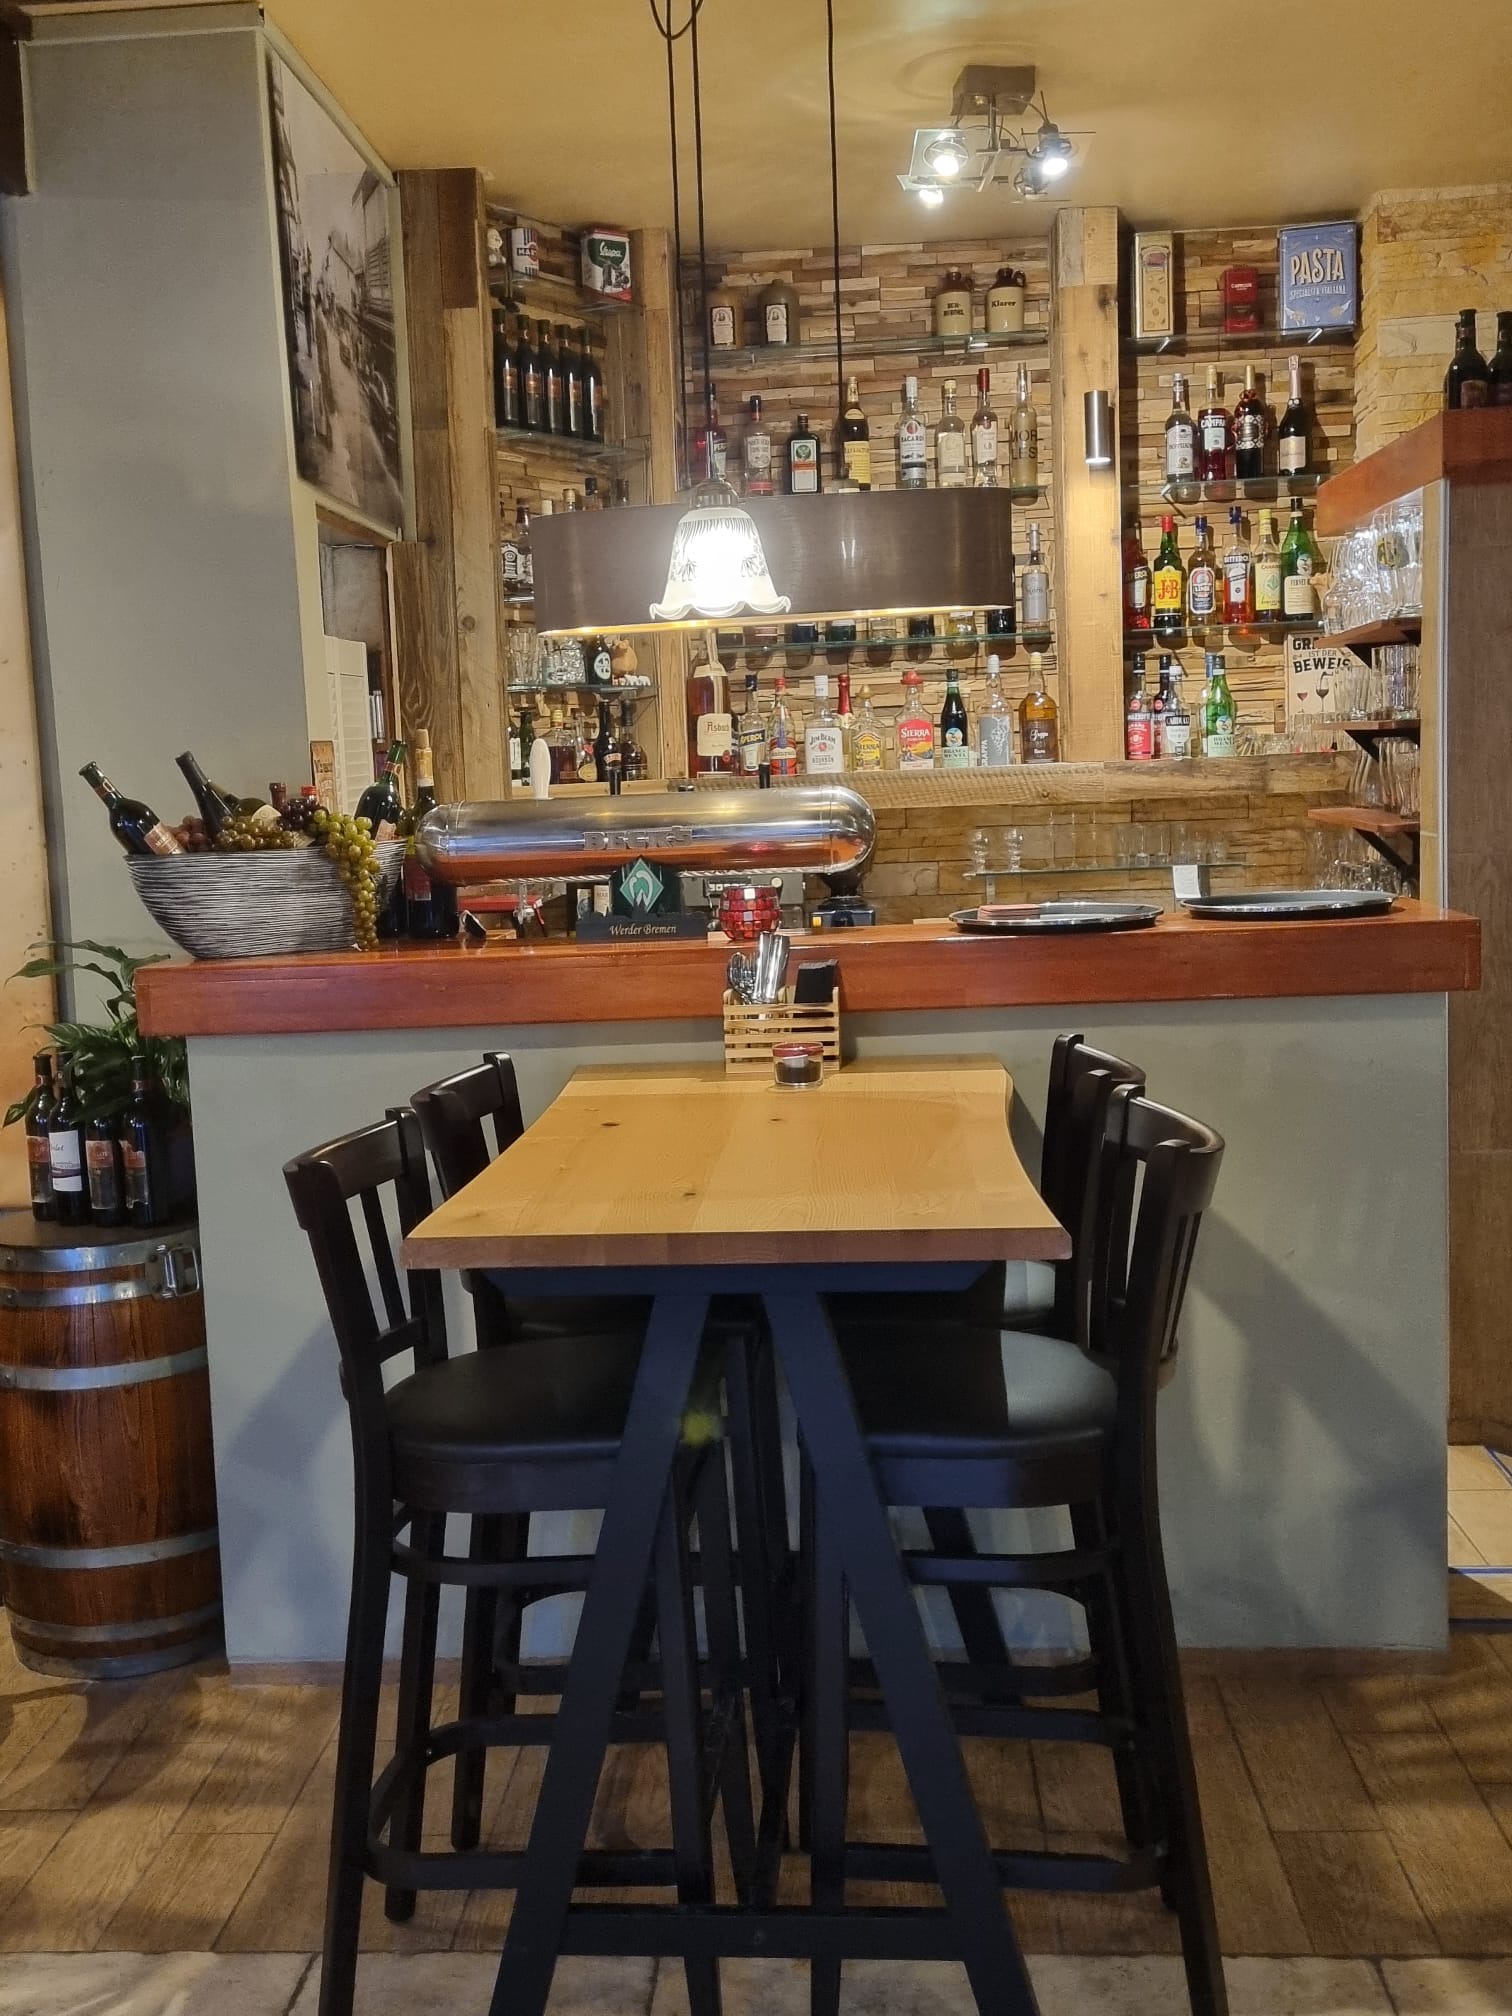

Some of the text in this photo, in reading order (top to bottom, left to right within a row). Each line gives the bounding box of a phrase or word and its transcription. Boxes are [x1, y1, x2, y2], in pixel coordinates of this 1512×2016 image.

[600, 241, 622, 257] Vespa
[1290, 247, 1345, 286] PASTA
[740, 733, 763, 745] APEROL
[820, 733, 836, 744] BEAM
[901, 729, 930, 738] SIERRA
[609, 922, 677, 936] Werder Bremen
